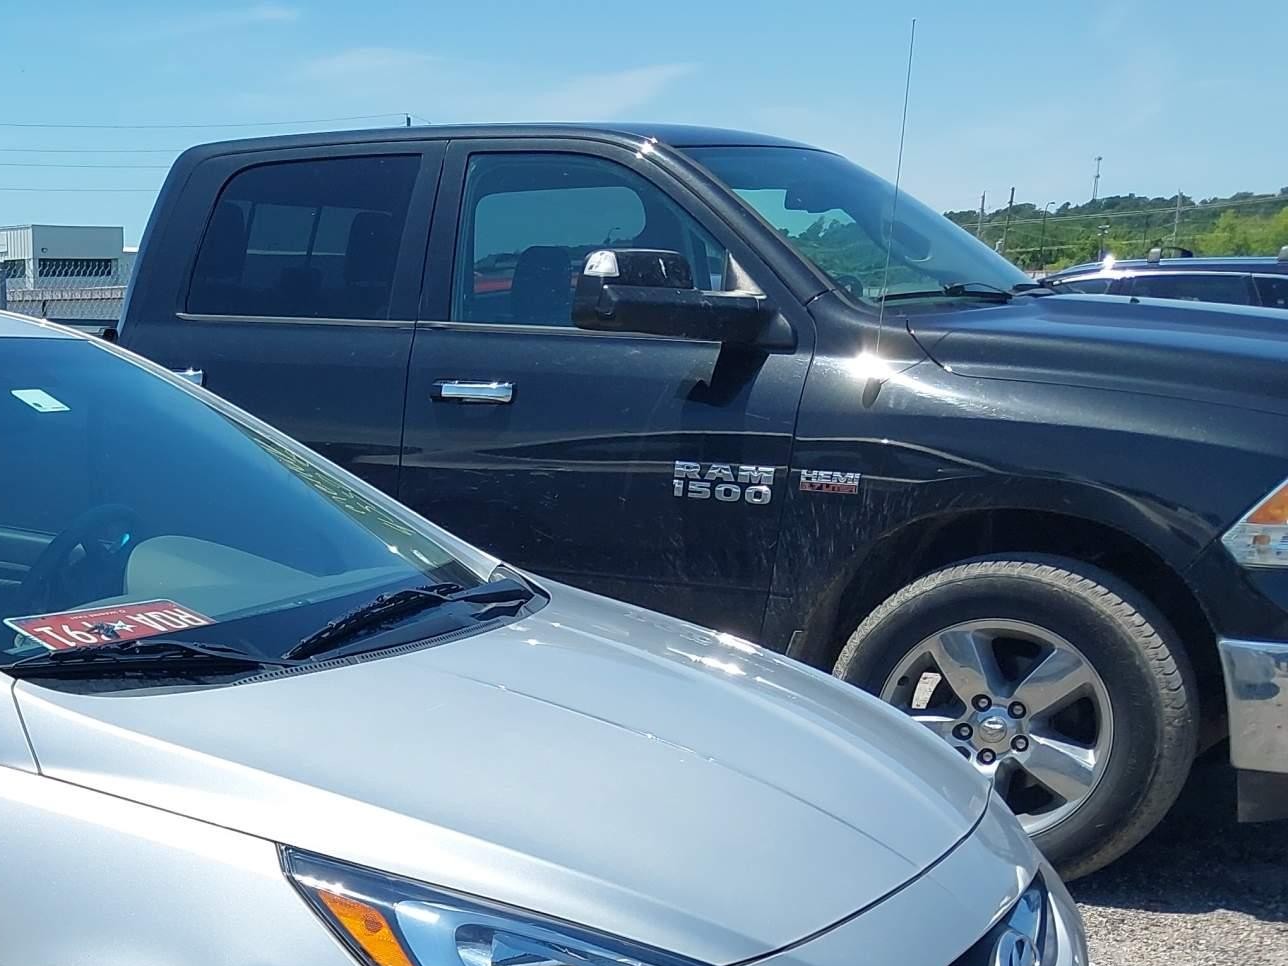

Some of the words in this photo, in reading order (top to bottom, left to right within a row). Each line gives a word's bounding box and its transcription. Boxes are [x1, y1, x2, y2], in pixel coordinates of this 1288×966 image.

[673, 460, 776, 485] RAM
[800, 469, 861, 484] HEMI
[672, 479, 772, 505] 1500
